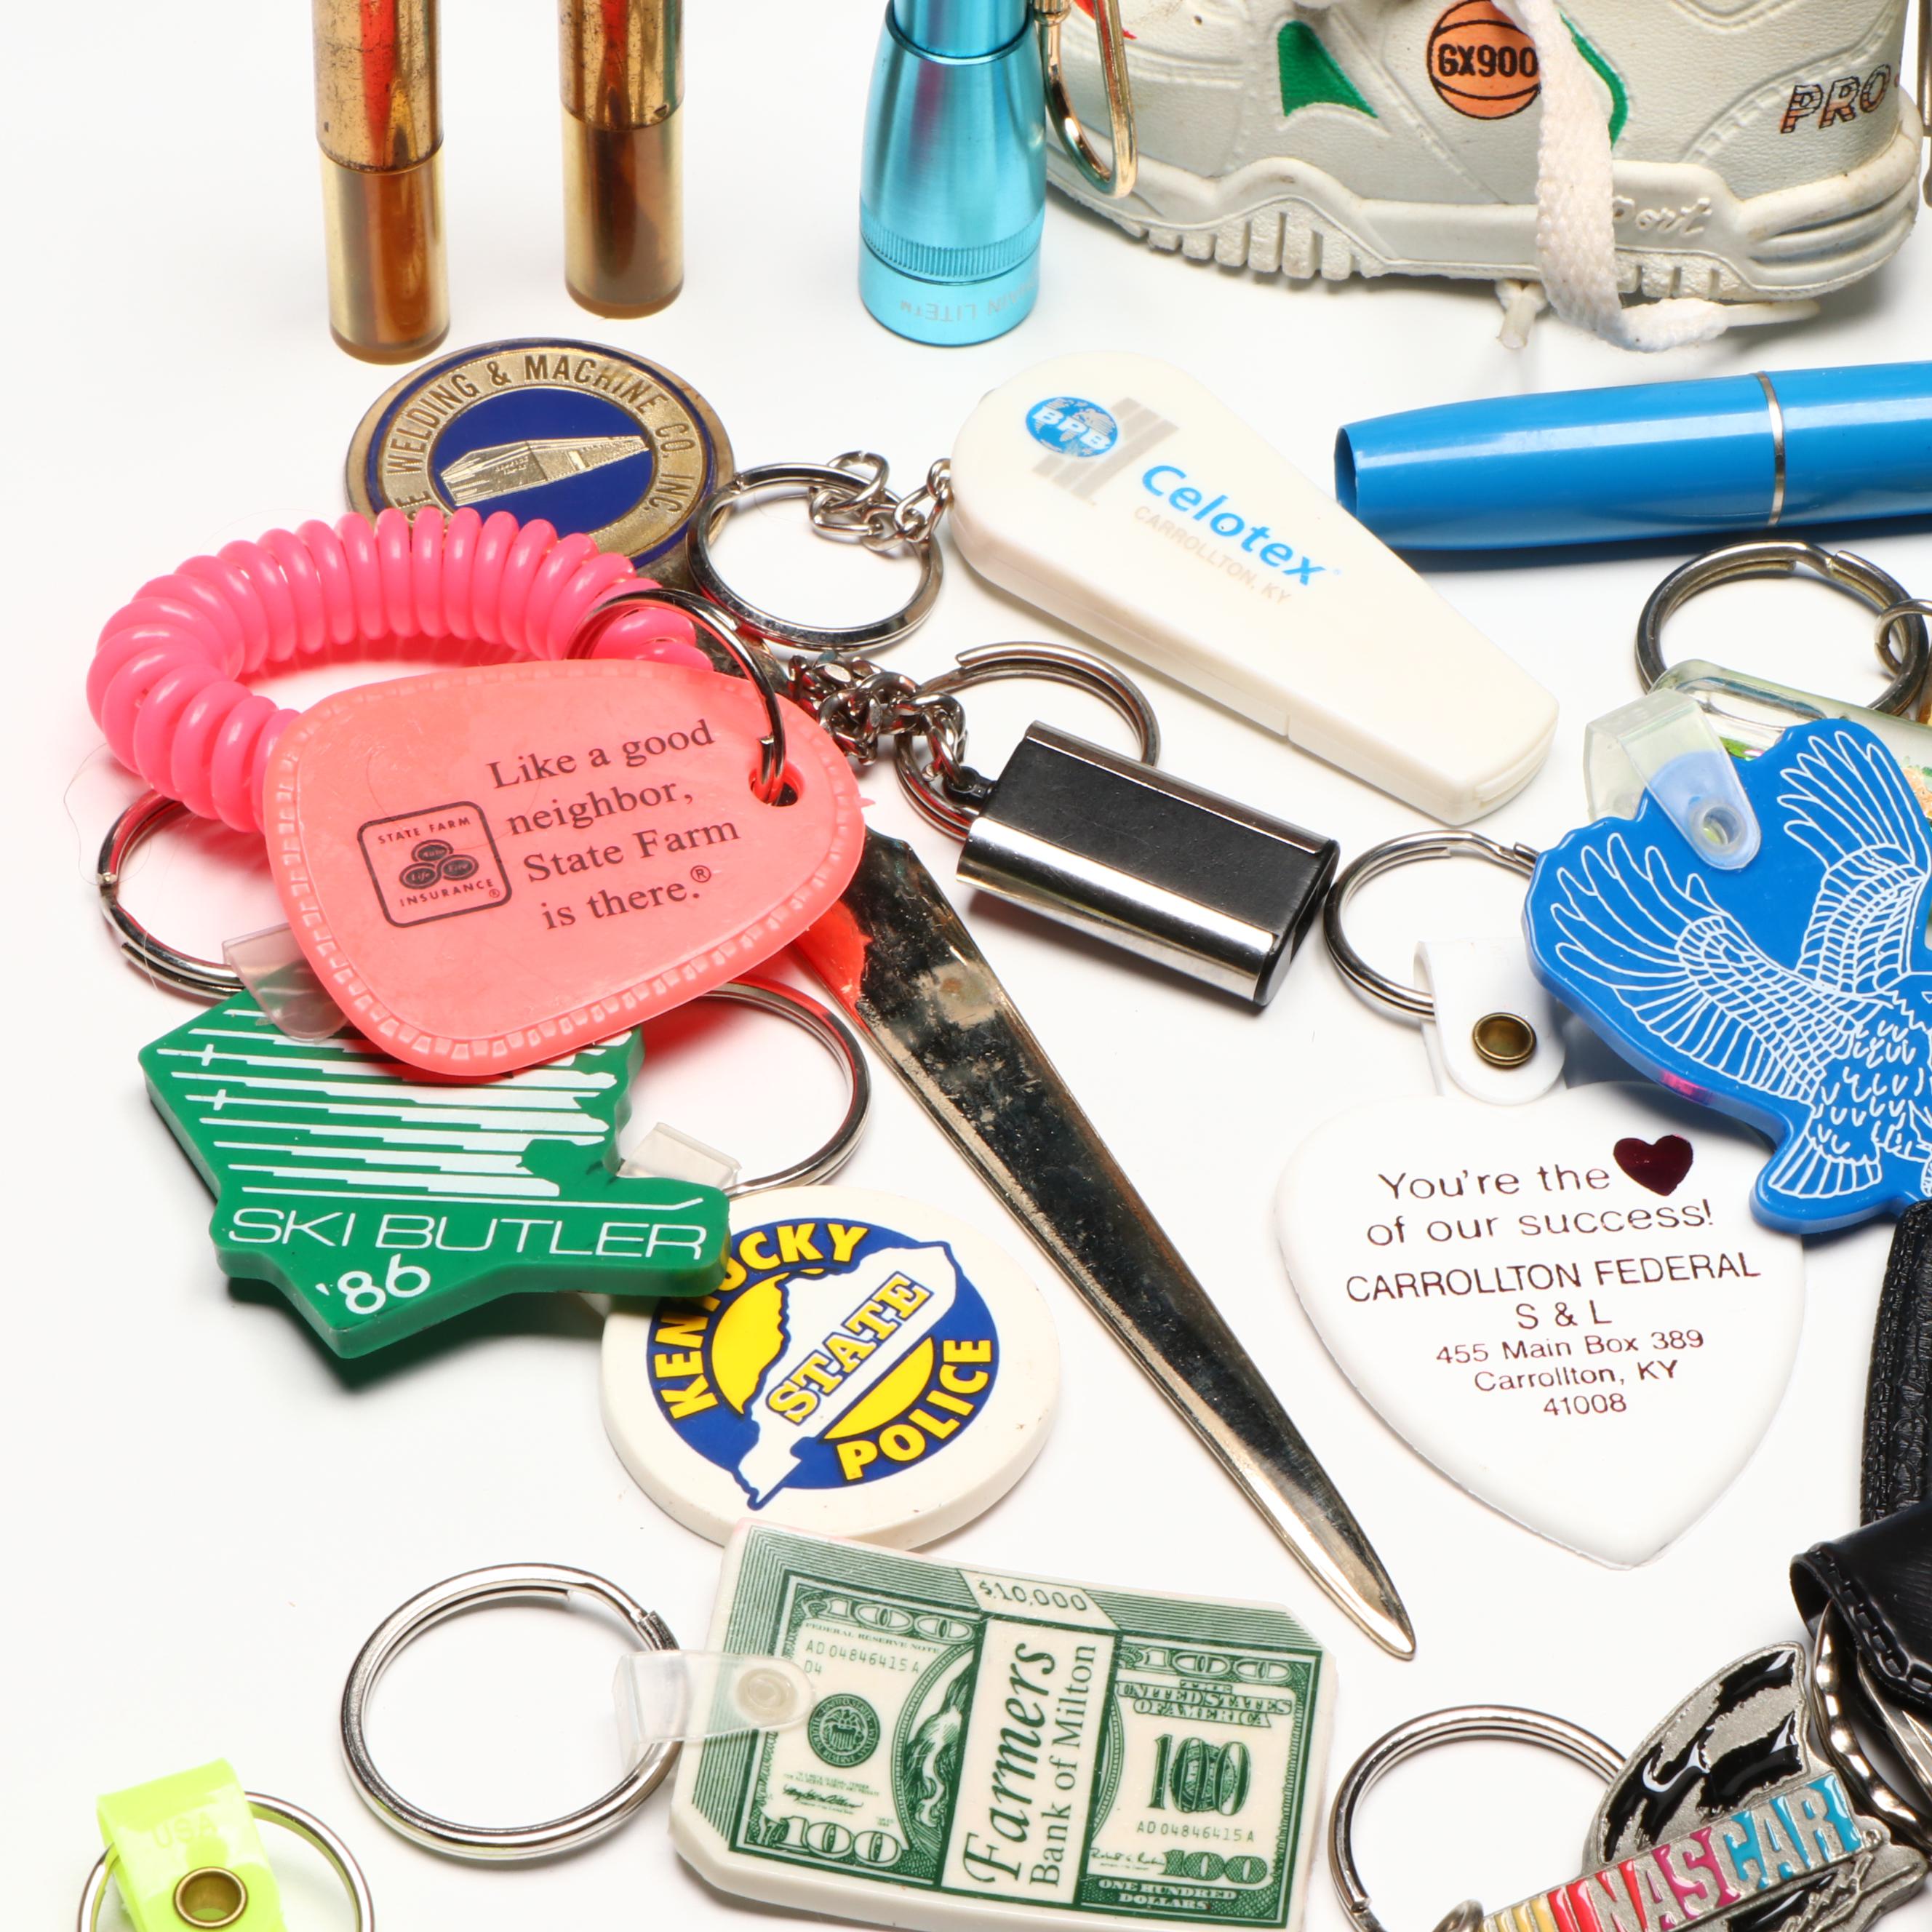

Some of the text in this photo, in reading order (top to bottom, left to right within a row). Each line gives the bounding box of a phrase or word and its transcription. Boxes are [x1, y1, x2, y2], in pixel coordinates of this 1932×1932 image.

[1781, 64, 1891, 133] PRO
[387, 374, 479, 474] WELDING
[487, 361, 512, 386] &
[524, 354, 668, 415] MACHINE
[1031, 406, 1111, 450] BPB
[1142, 465, 1326, 586] Celotex
[1260, 581, 1292, 606] KY
[486, 719, 716, 789] Like a good
[378, 817, 471, 844] STATE FARM
[506, 781, 693, 836] neighbor,
[523, 822, 741, 882] State Farm
[400, 879, 494, 906] INSURANCE
[541, 902, 576, 930] is
[1378, 1165, 1610, 1199] You're the
[228, 1208, 706, 1260] SKI BUTLER
[1368, 1199, 1714, 1246] of our success!
[1346, 1252, 1761, 1302] CARROLLTON FEDERAL
[1515, 1300, 1612, 1329] S & L
[766, 1272, 935, 1425] STATE
[1437, 1329, 1704, 1364] 455 Main Box 389
[1474, 1360, 1678, 1392] Carrollton, KY
[837, 1340, 991, 1482] POLICE
[1543, 1393, 1627, 1416] 41008
[805, 1622, 940, 1654] FEDERAL RESERVE NOTE
[818, 1598, 973, 1645] 100
[1135, 1646, 1292, 1684] 100
[1116, 1682, 1292, 1715] UNITED STATES
[1134, 1697, 1271, 1728] OF AMERICA
[962, 1642, 1055, 1883] Farmers
[1030, 1645, 1097, 1887] Bank of Milton
[1146, 1733, 1251, 1816] 100
[153, 1812, 217, 1848] USA
[778, 1816, 903, 1867] 100
[1158, 1849, 1268, 1884] 100
[1589, 1776, 1859, 1931] NASCAR
[1098, 1879, 1237, 1900] ONE HUNDRED
[1119, 1893, 1208, 1910] DOLLARS
